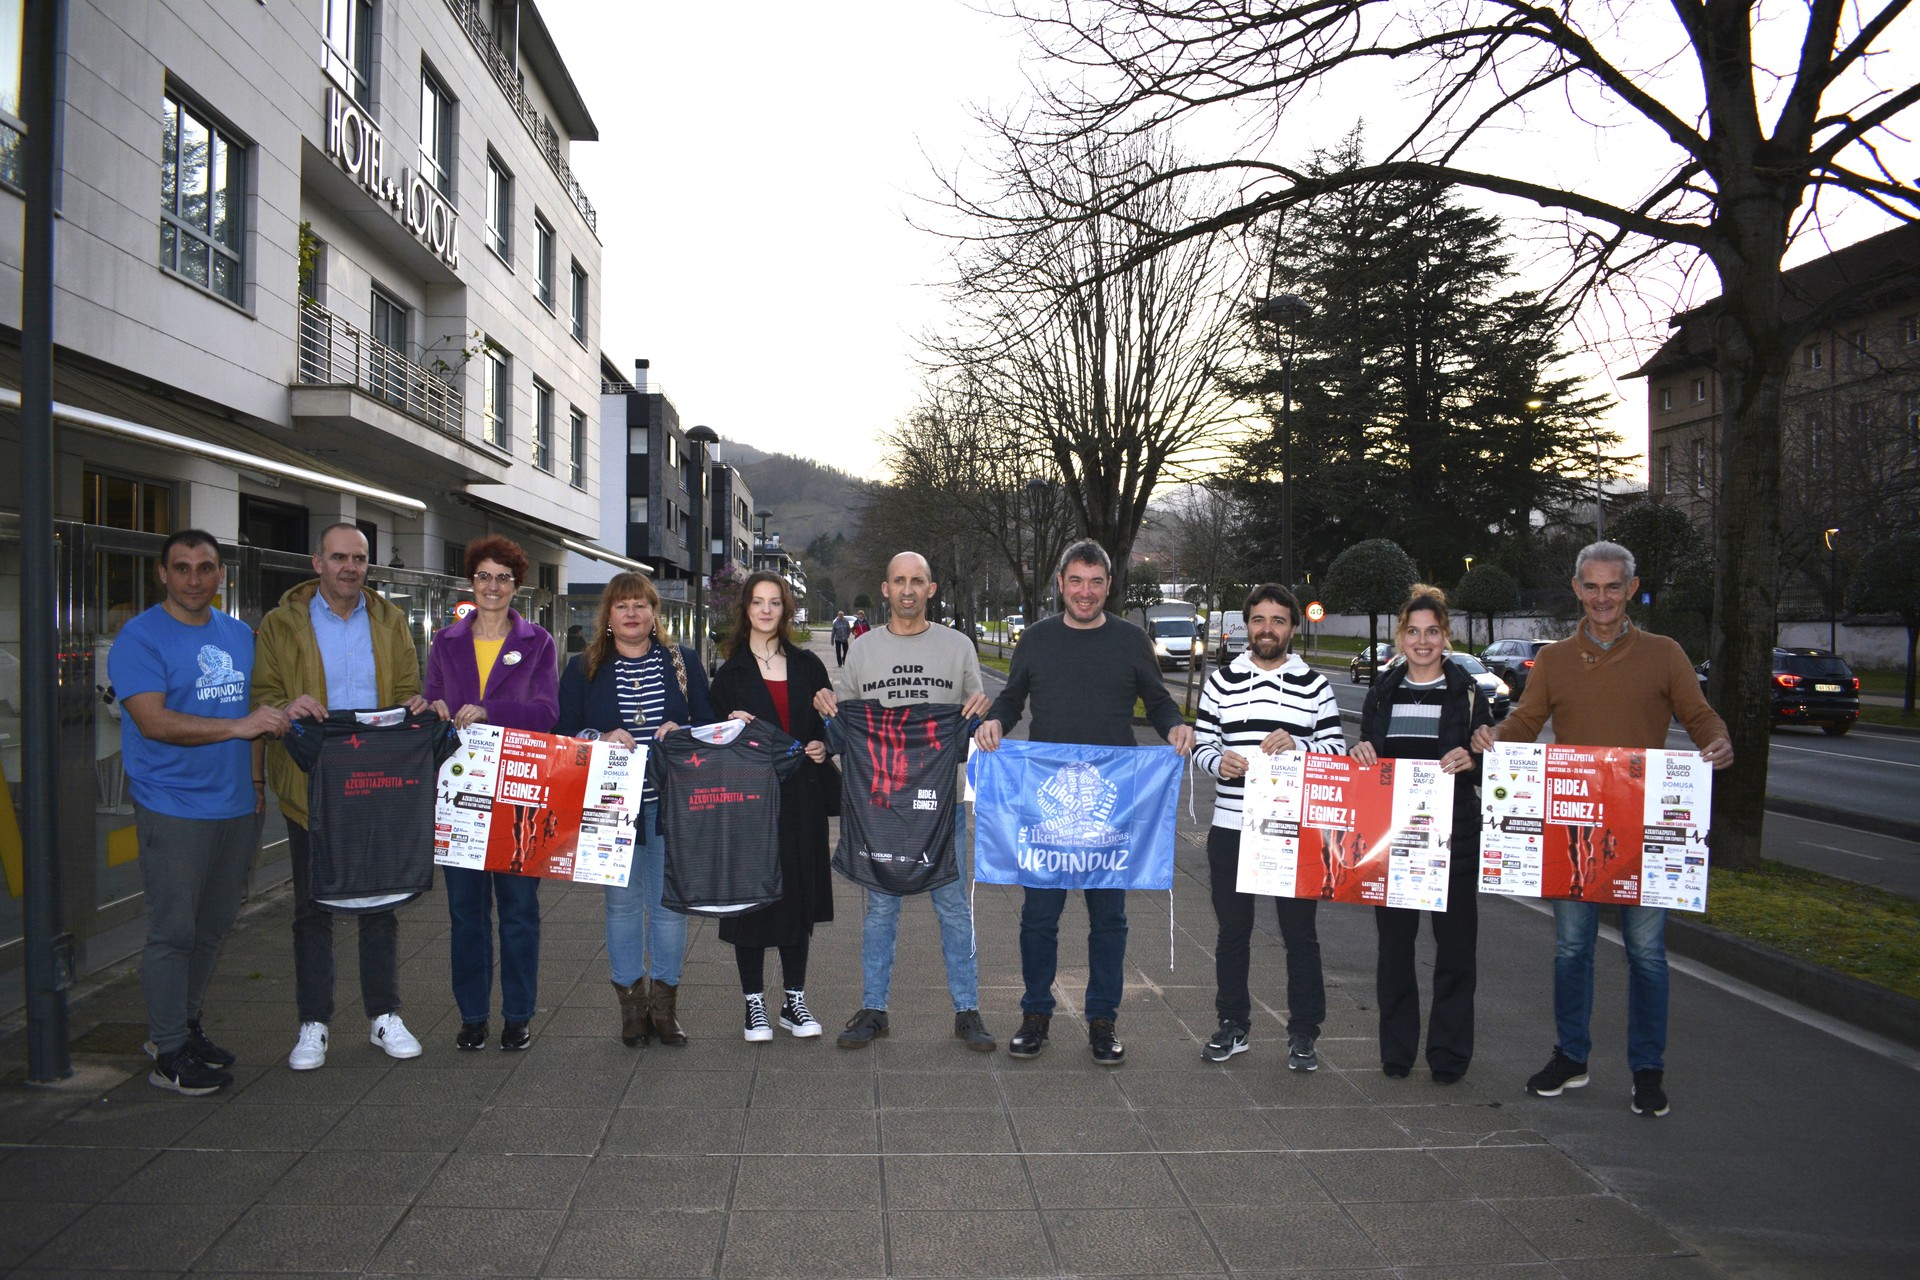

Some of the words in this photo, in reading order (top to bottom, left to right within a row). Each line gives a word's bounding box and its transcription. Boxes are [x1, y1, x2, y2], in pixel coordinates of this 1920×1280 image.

[326, 86, 386, 200] HOTEL
[403, 167, 460, 270] LOIOLA
[892, 665, 924, 674] OUR
[196, 682, 244, 701] URDINDUZ
[863, 677, 953, 692] IMAGINATION
[888, 690, 929, 699] FLIES
[469, 738, 495, 747] EUSKADI
[505, 736, 547, 748] AZKOITIAZPEITIA
[575, 744, 589, 767] 2023
[1548, 753, 1594, 762] AZKOITIAZPEITIA
[506, 760, 538, 779] BIDEA
[1307, 760, 1349, 770] AZKOITIAZPEITIA
[1380, 762, 1392, 785] 2023
[1630, 753, 1643, 778] 2023
[345, 777, 403, 790] AZKOITIAZPEITIA
[1066, 767, 1079, 793] Julene
[1080, 771, 1095, 785] Igor
[1553, 778, 1588, 796] BIDEA
[503, 781, 541, 800] EGINEZ
[544, 787, 549, 801] !
[689, 792, 744, 805] AZKOITIAZPEITIA
[918, 789, 936, 799] BIDEA
[1041, 776, 1081, 812] Luken
[1080, 786, 1097, 812] Irati
[1311, 784, 1343, 802] BIDEA
[913, 800, 938, 810] EGINEZ!
[1037, 788, 1058, 817] Paule
[1553, 801, 1594, 819] EGINEZ
[1598, 803, 1604, 820] !
[1045, 810, 1083, 832] Oihane
[1309, 805, 1347, 824] EGINEZ
[1350, 809, 1356, 824] !
[1031, 828, 1058, 844] Iker
[1102, 832, 1129, 844] Lucas
[1018, 848, 1129, 874] URDINDUZ
